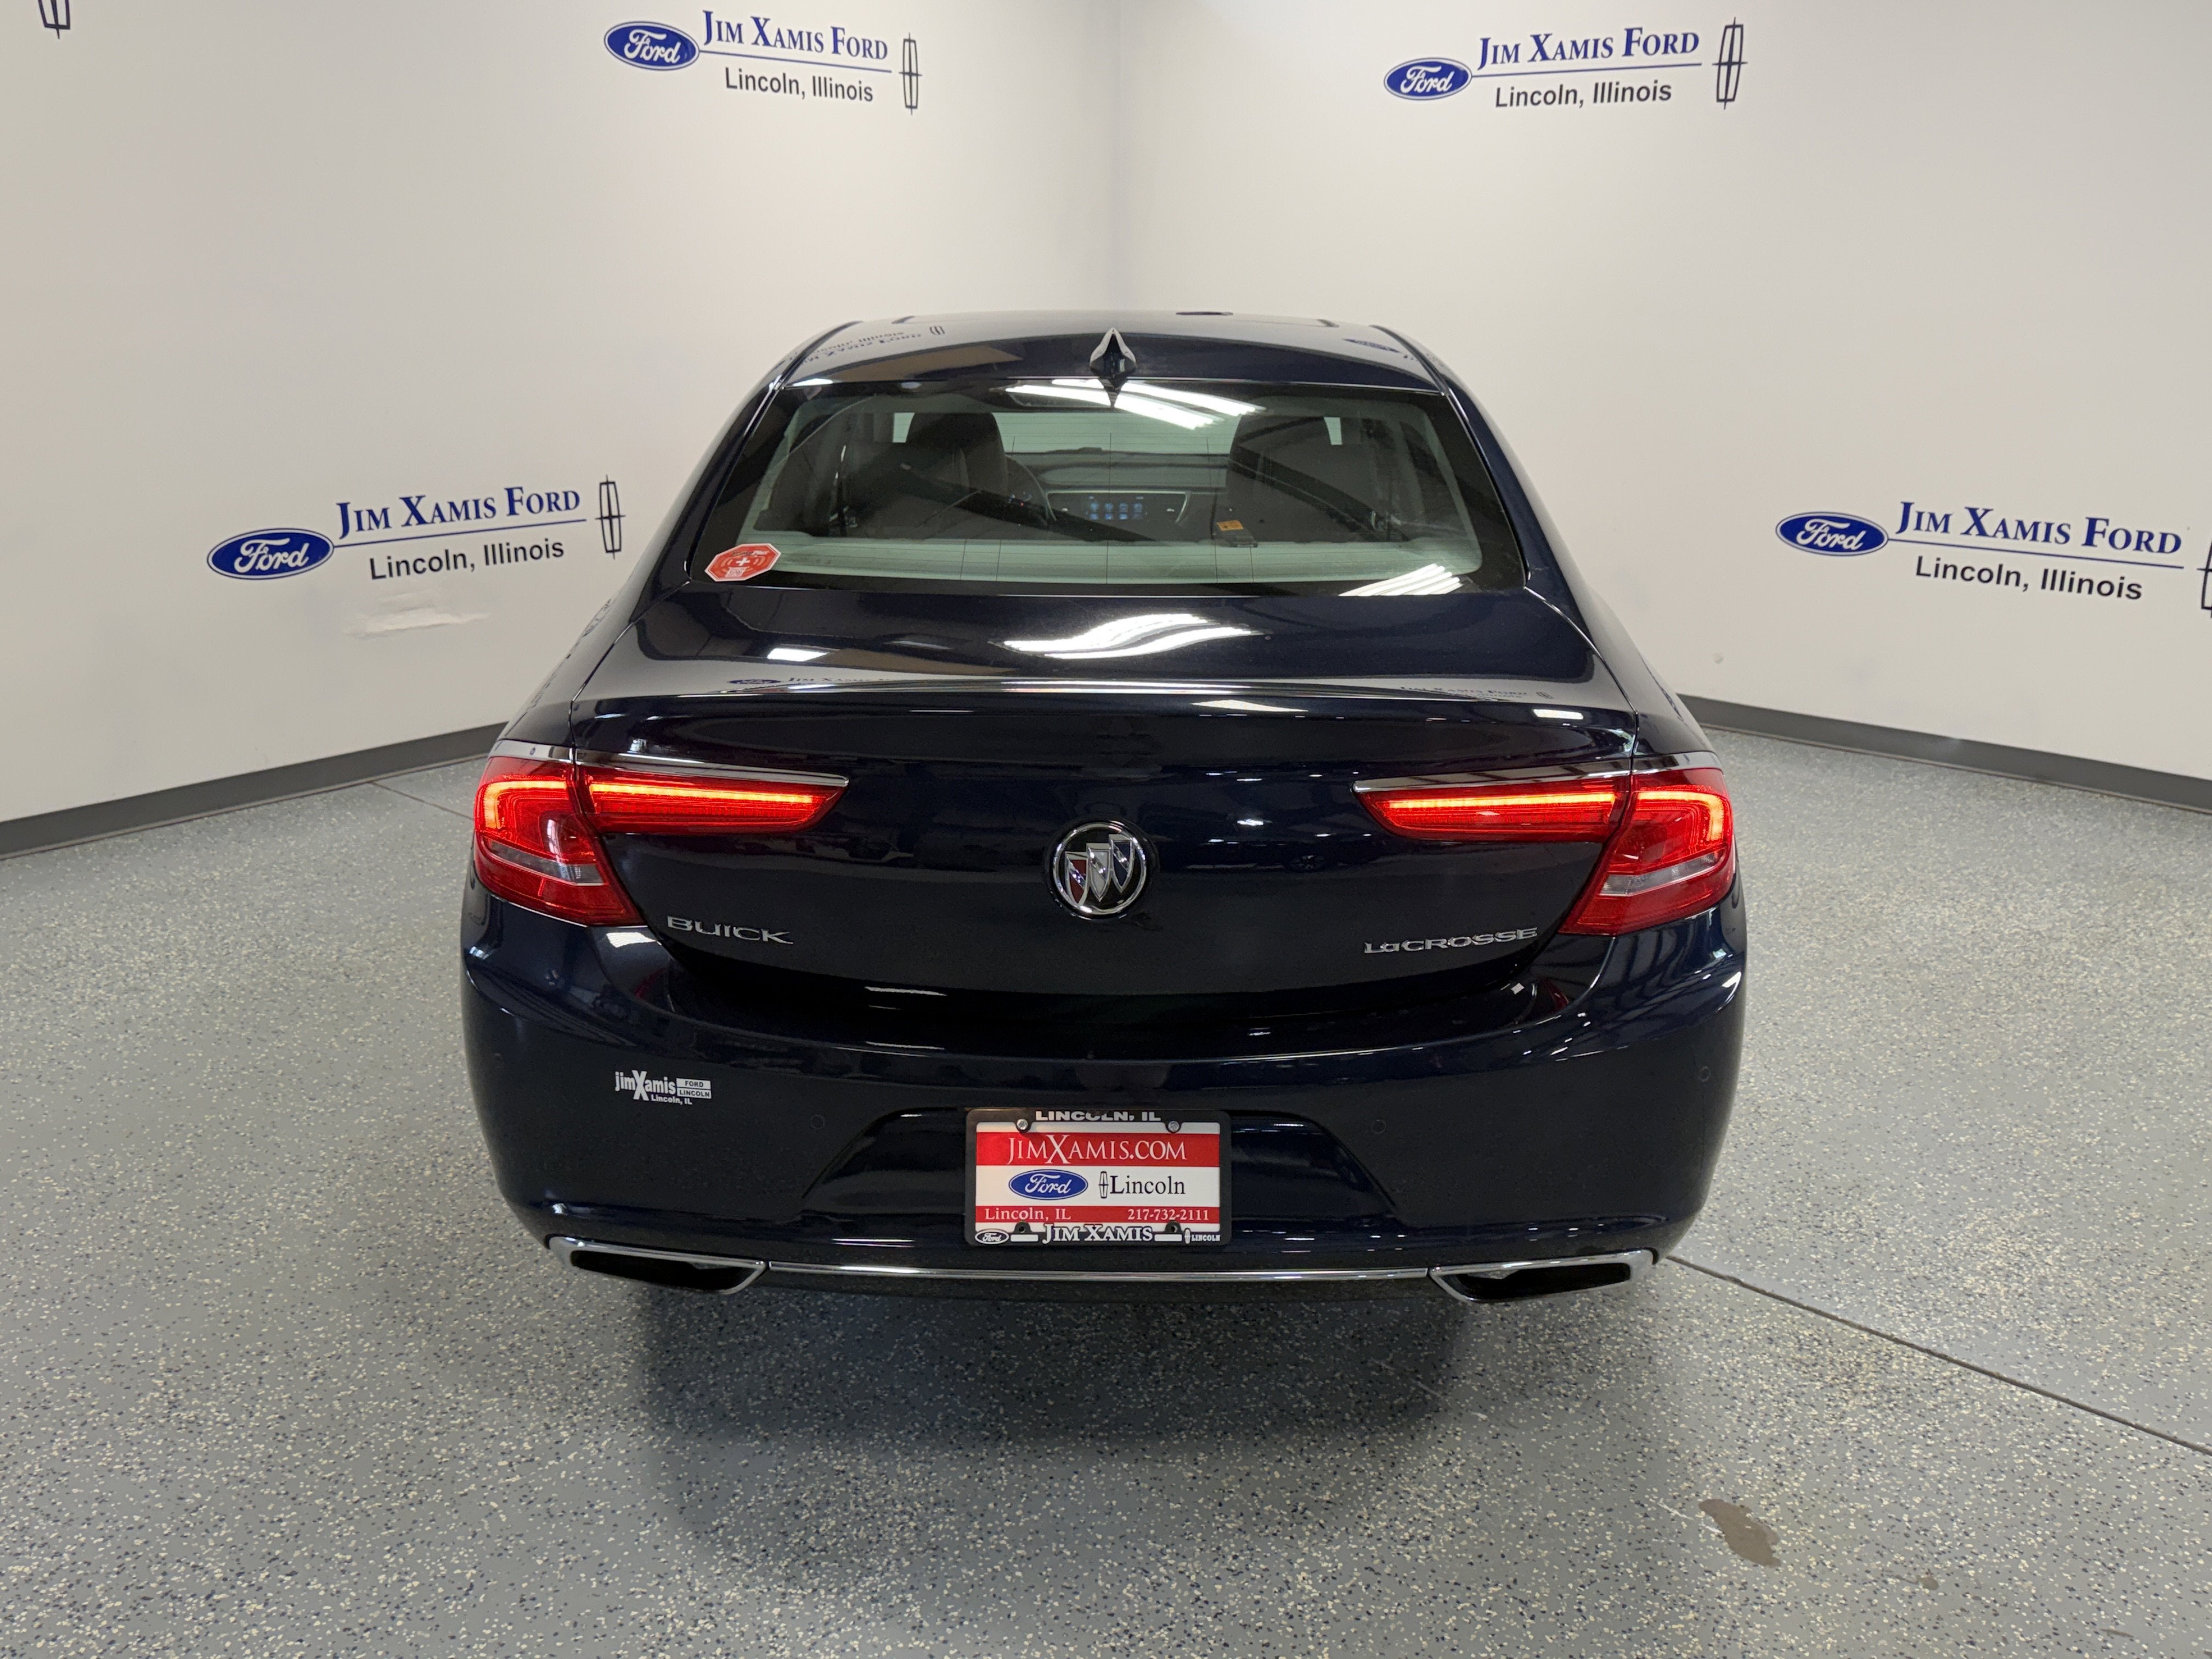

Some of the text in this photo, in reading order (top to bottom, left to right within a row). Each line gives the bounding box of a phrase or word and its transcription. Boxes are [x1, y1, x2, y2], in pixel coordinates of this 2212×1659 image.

[623, 29, 681, 64] Ford
[703, 10, 888, 60] JIM XAMIS FORD
[1477, 27, 1699, 71] JIM XAMIS FORD
[725, 67, 874, 102] Lincoln, Illinois
[1400, 66, 1454, 93] Ford
[1495, 80, 1672, 108] Lincoln, Illinois
[336, 486, 580, 539] JIM XAMIS FORD
[1796, 518, 1865, 551] Ford
[1895, 501, 2183, 555] JIM XAMIS FORD
[234, 538, 309, 573] Ford
[369, 538, 565, 579] Lincoln, Illinois
[1915, 555, 2143, 600] Lincoln, Illinois
[667, 916, 794, 945] BUICK
[651, 1094, 683, 1105] Lincoln,
[679, 1090, 710, 1098] LINCOLN
[1141, 1111, 1161, 1121] IL
[1024, 1173, 1072, 1194] Ford
[1109, 1175, 1186, 1195] Lincoln
[985, 1207, 1071, 1221] Lincoln, IL
[1127, 1209, 1209, 1221] 217-732-2111
[1042, 1223, 1153, 1244] JIM XAMIS
